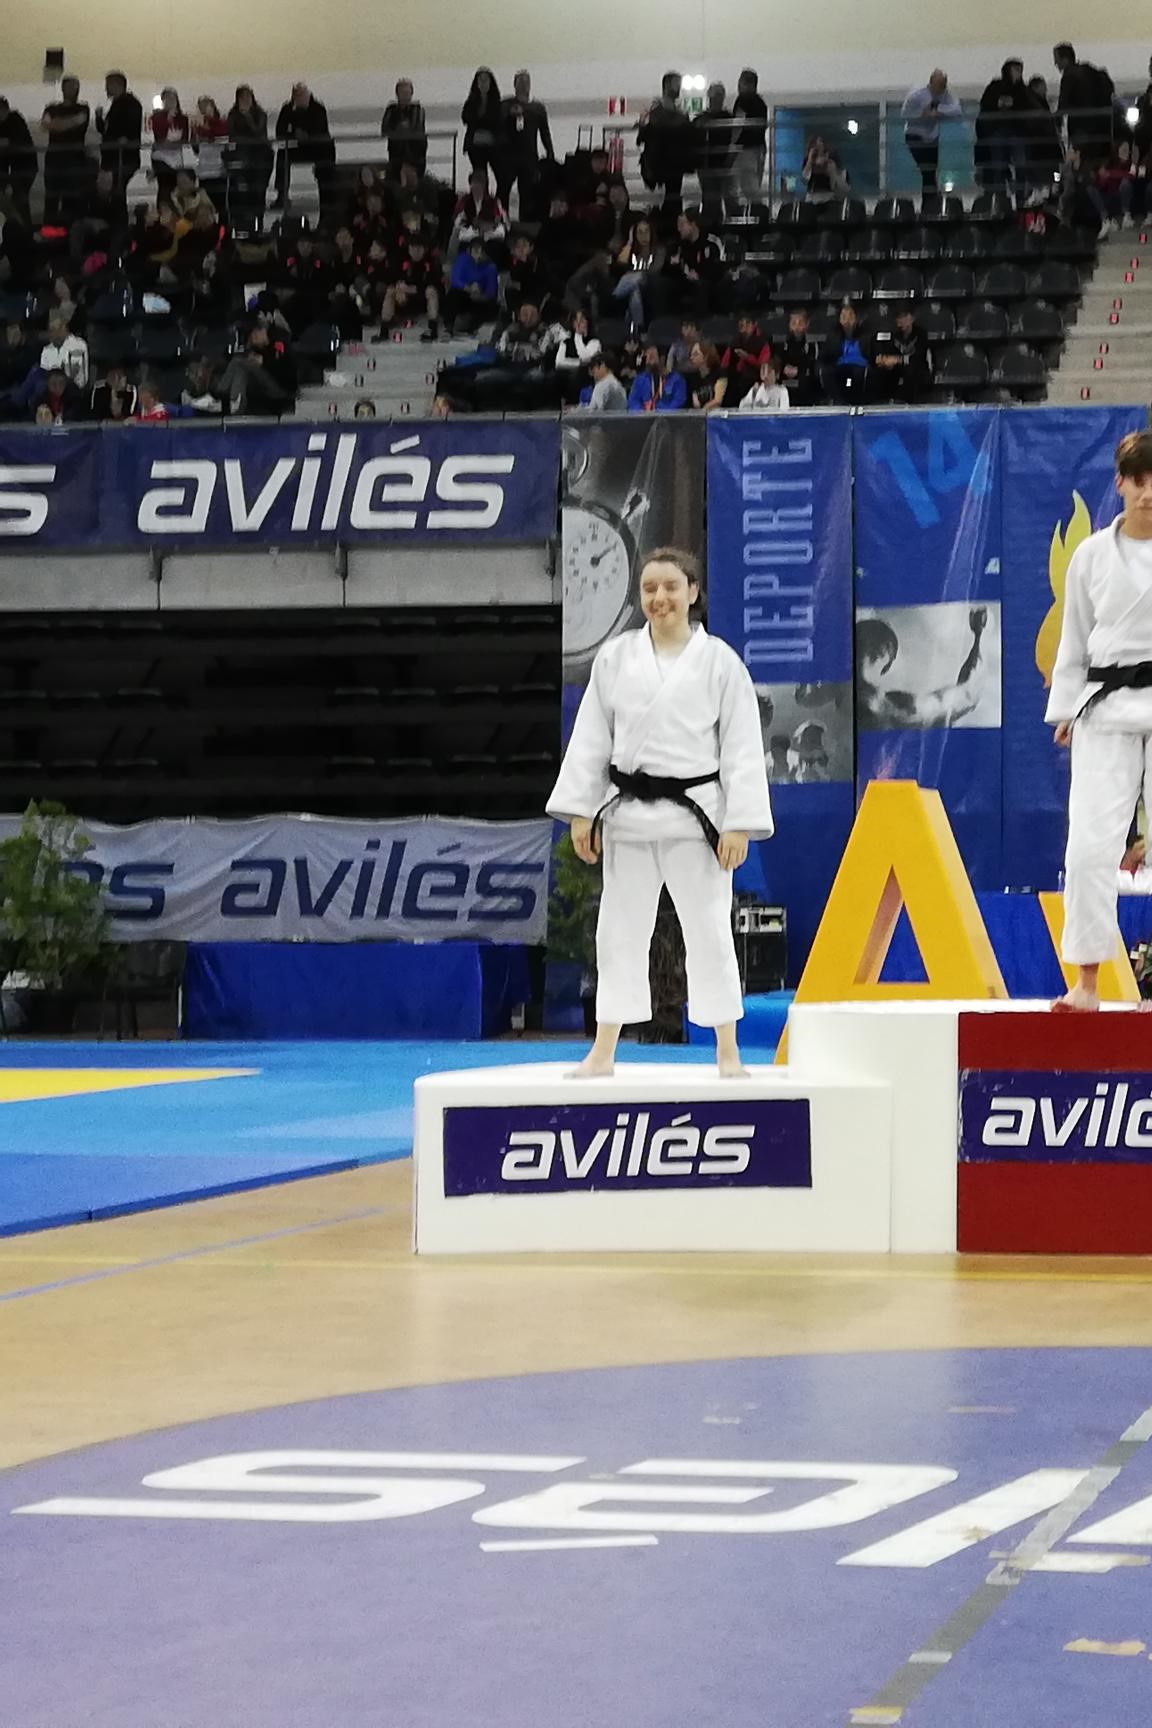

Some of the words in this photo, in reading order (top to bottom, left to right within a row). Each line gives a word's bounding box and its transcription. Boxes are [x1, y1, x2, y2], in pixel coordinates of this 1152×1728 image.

[137, 433, 514, 533] avilés
[742, 438, 814, 665] DEPORTE
[221, 840, 544, 921] avilés
[501, 1113, 755, 1181] avilés
